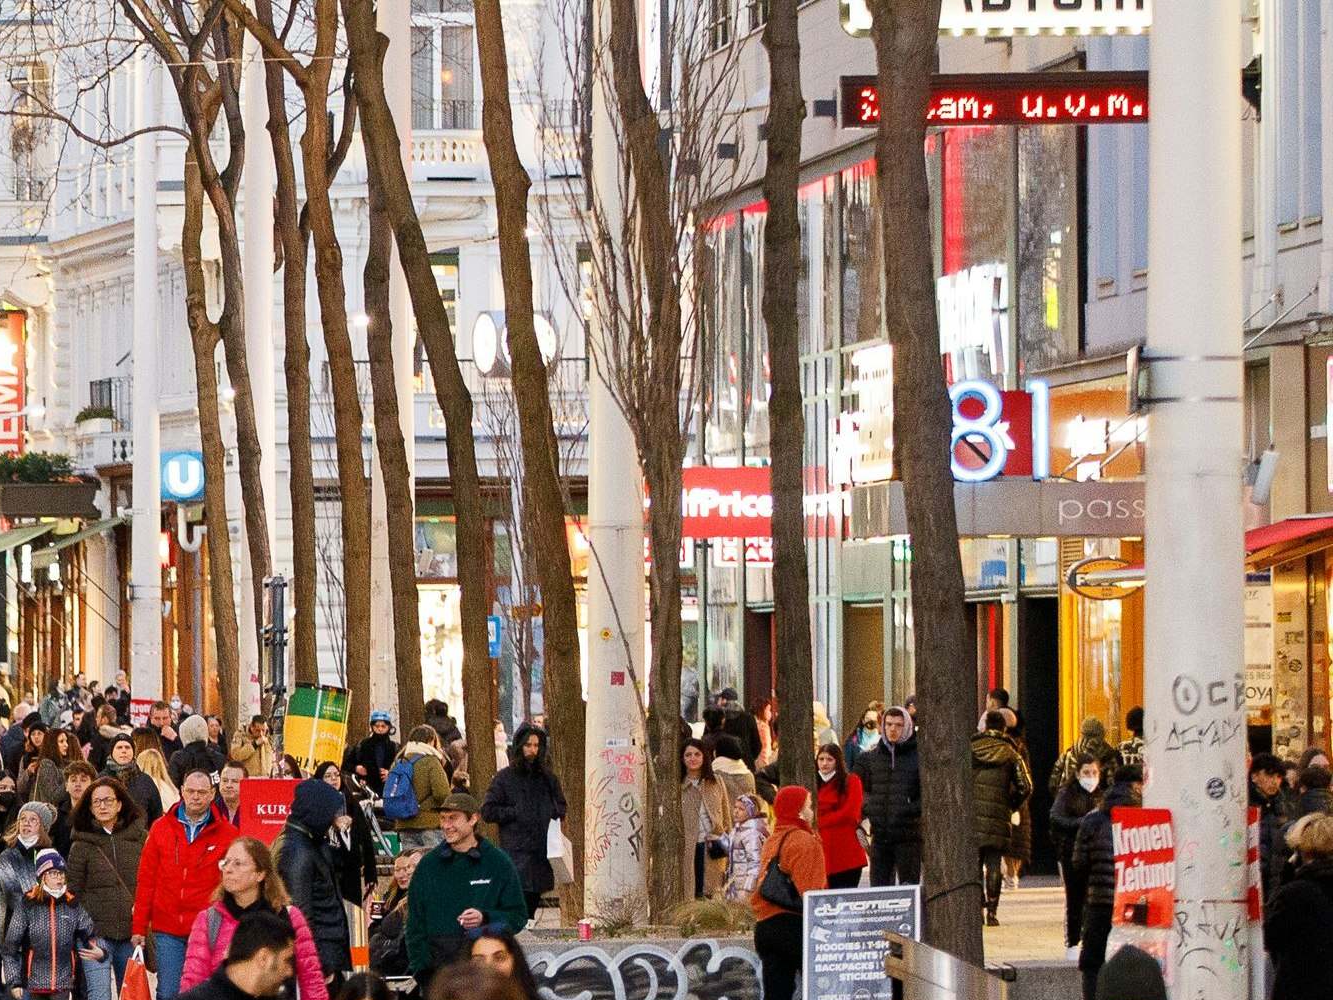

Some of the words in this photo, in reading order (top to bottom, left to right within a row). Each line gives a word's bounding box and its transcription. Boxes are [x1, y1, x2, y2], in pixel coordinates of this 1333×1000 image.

[1111, 822, 1174, 857] Kronen
[1114, 857, 1176, 894] Zeitung
[814, 941, 862, 952] HOODIES
[868, 939, 890, 950] T-SH
[814, 952, 846, 963] ARMY
[846, 949, 879, 962] PANTS
[814, 961, 876, 973] BACKPACKS
[838, 970, 887, 982] STICKERS
